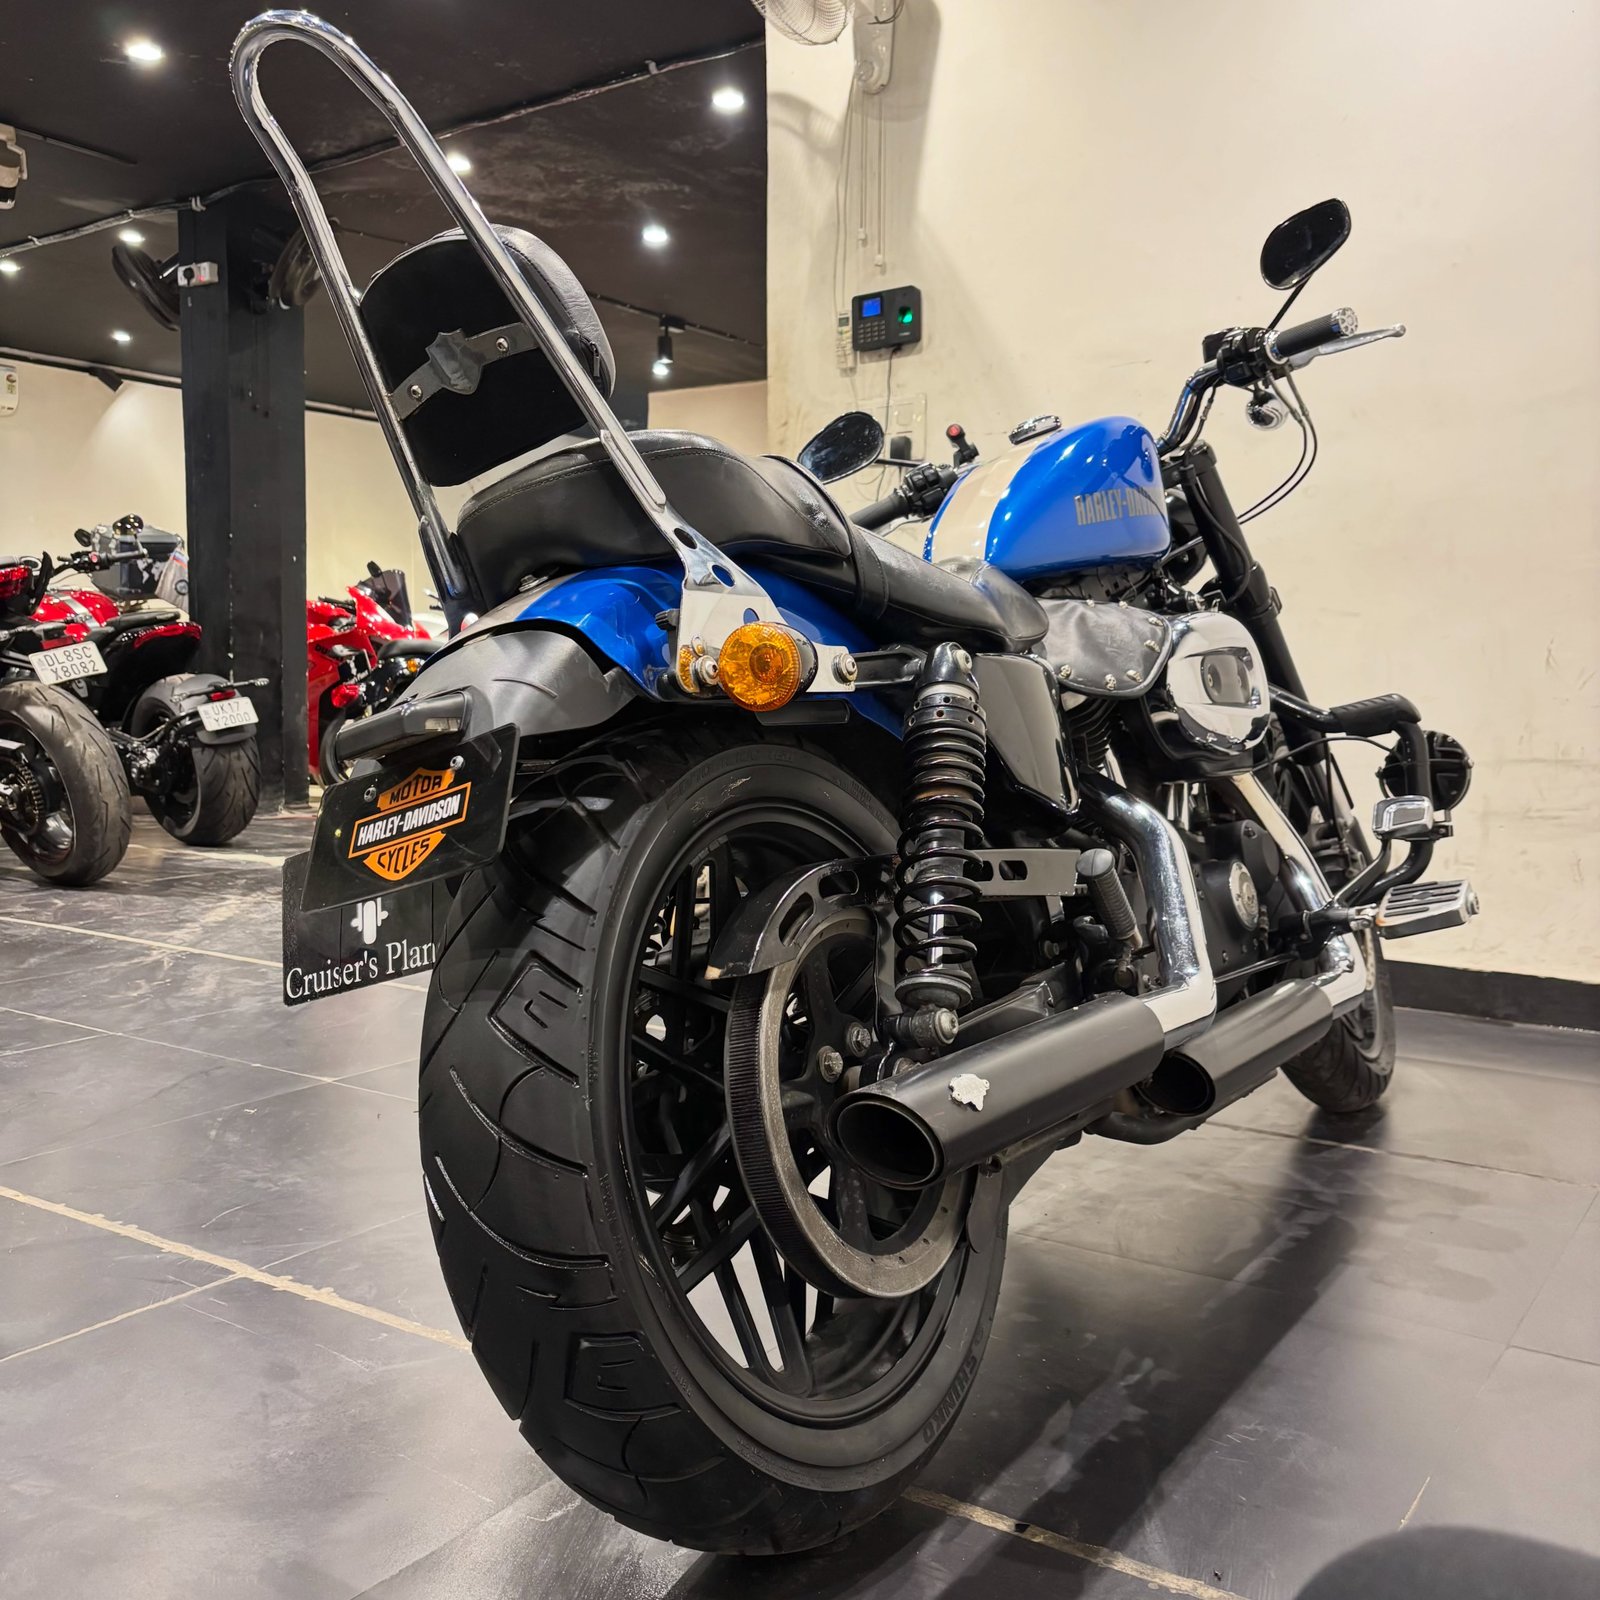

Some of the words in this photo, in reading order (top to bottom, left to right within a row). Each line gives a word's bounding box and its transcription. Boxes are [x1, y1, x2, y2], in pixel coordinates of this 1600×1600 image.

[43, 646, 92, 667] DL8SC
[50, 660, 99, 681] X8082
[211, 701, 240, 716] UK17
[213, 711, 251, 727] Y2000
[389, 774, 443, 806] MOTOR
[357, 793, 461, 847] HARLEY-DAVIDSON
[376, 837, 431, 874] CYCLES
[285, 950, 379, 1000] Cruiser's
[385, 938, 437, 975] Plan
